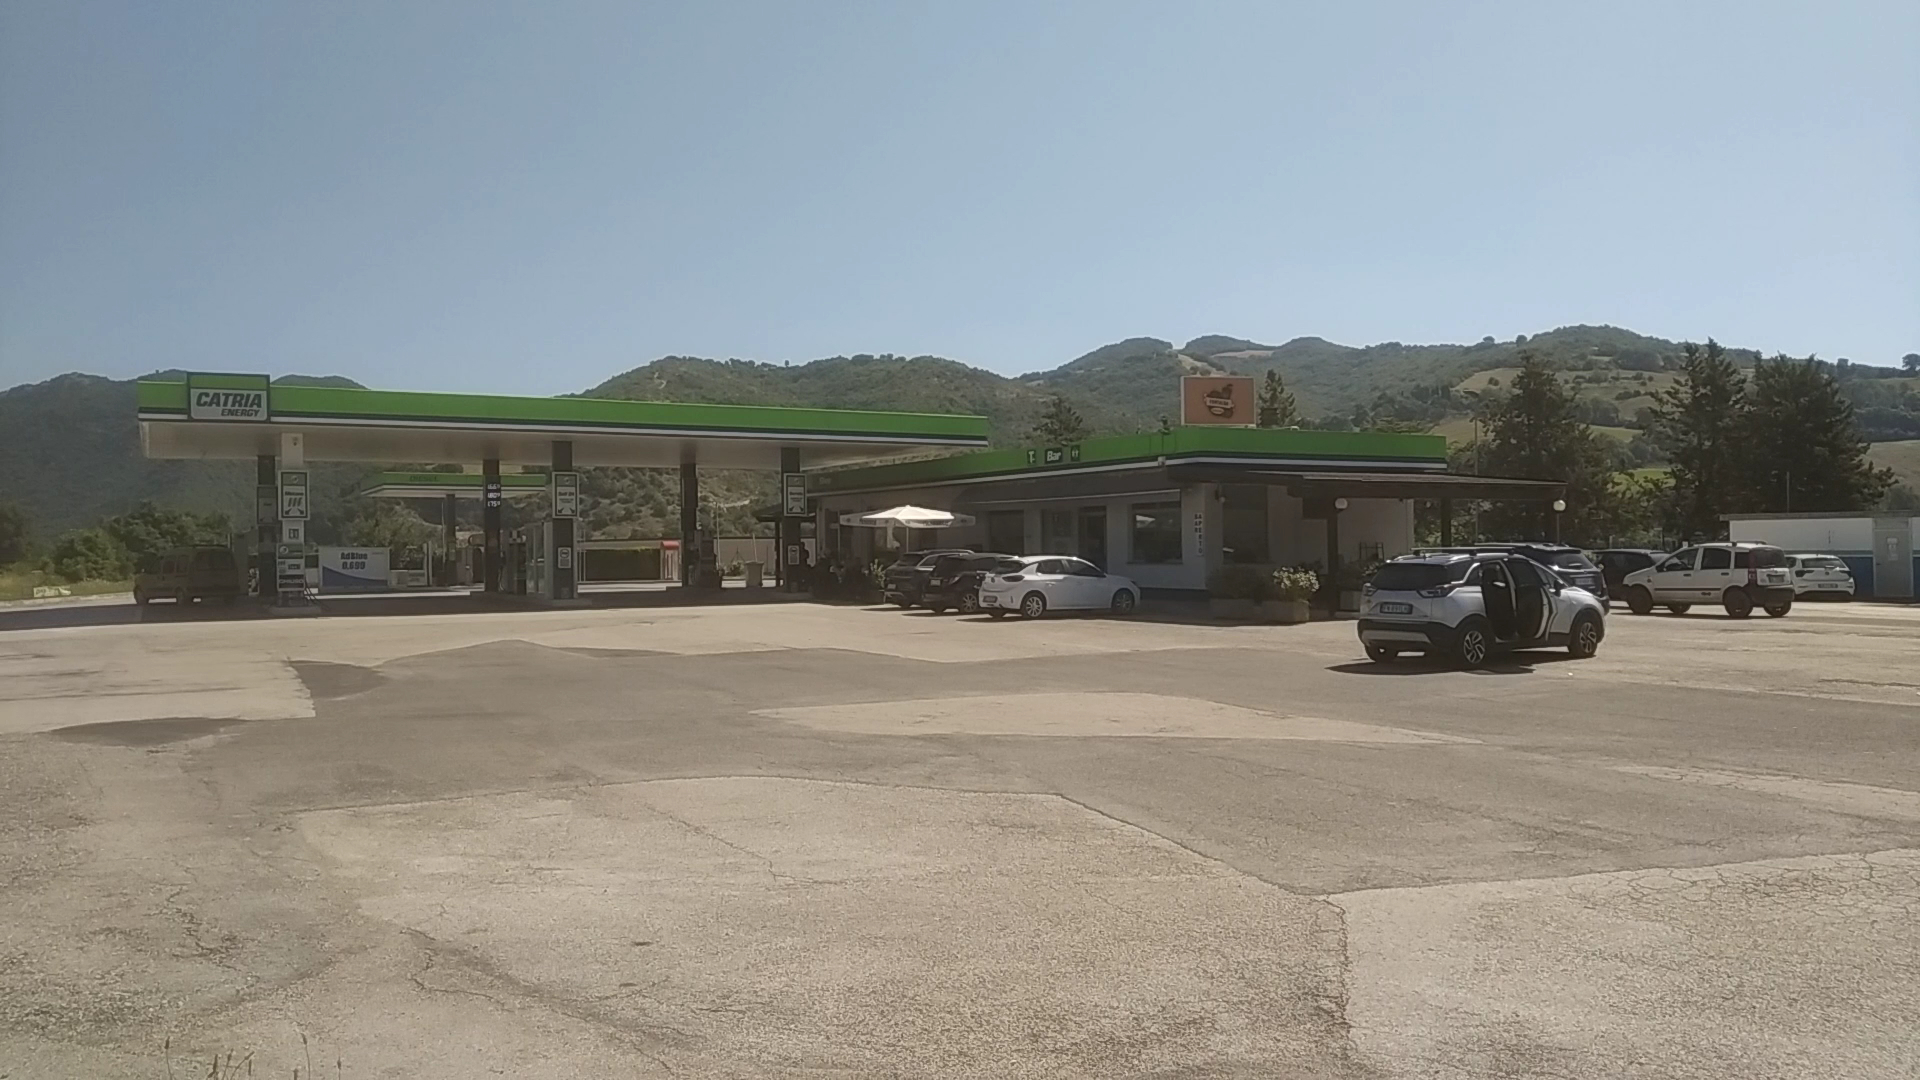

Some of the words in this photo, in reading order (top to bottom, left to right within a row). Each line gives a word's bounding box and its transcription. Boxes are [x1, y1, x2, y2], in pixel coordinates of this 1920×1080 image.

[196, 392, 262, 408] CATRIA
[220, 408, 260, 417] ENERGY
[1046, 450, 1062, 462] Bar
[340, 552, 368, 560] AdBlue
